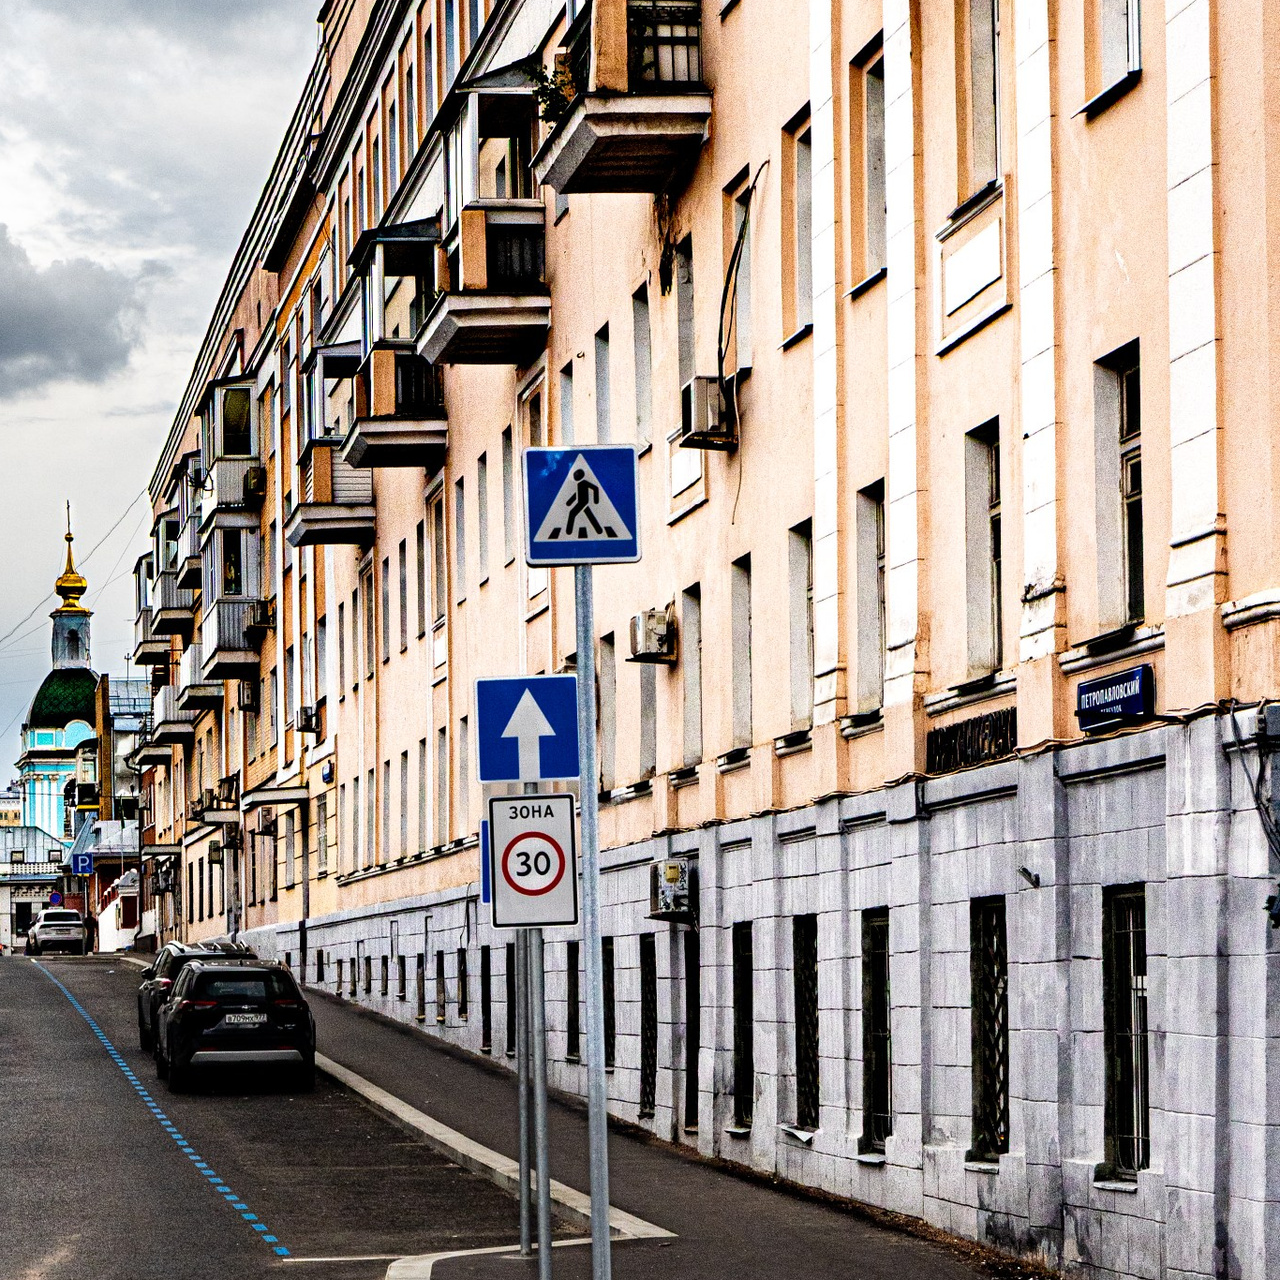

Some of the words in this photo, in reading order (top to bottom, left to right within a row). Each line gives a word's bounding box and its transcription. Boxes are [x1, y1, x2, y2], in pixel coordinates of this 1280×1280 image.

[1081, 676, 1140, 710] ПЕТРОПАВЛОВСКИЙ
[509, 805, 554, 819] ЗОНА
[78, 856, 89, 872] P
[516, 851, 551, 876] 30
